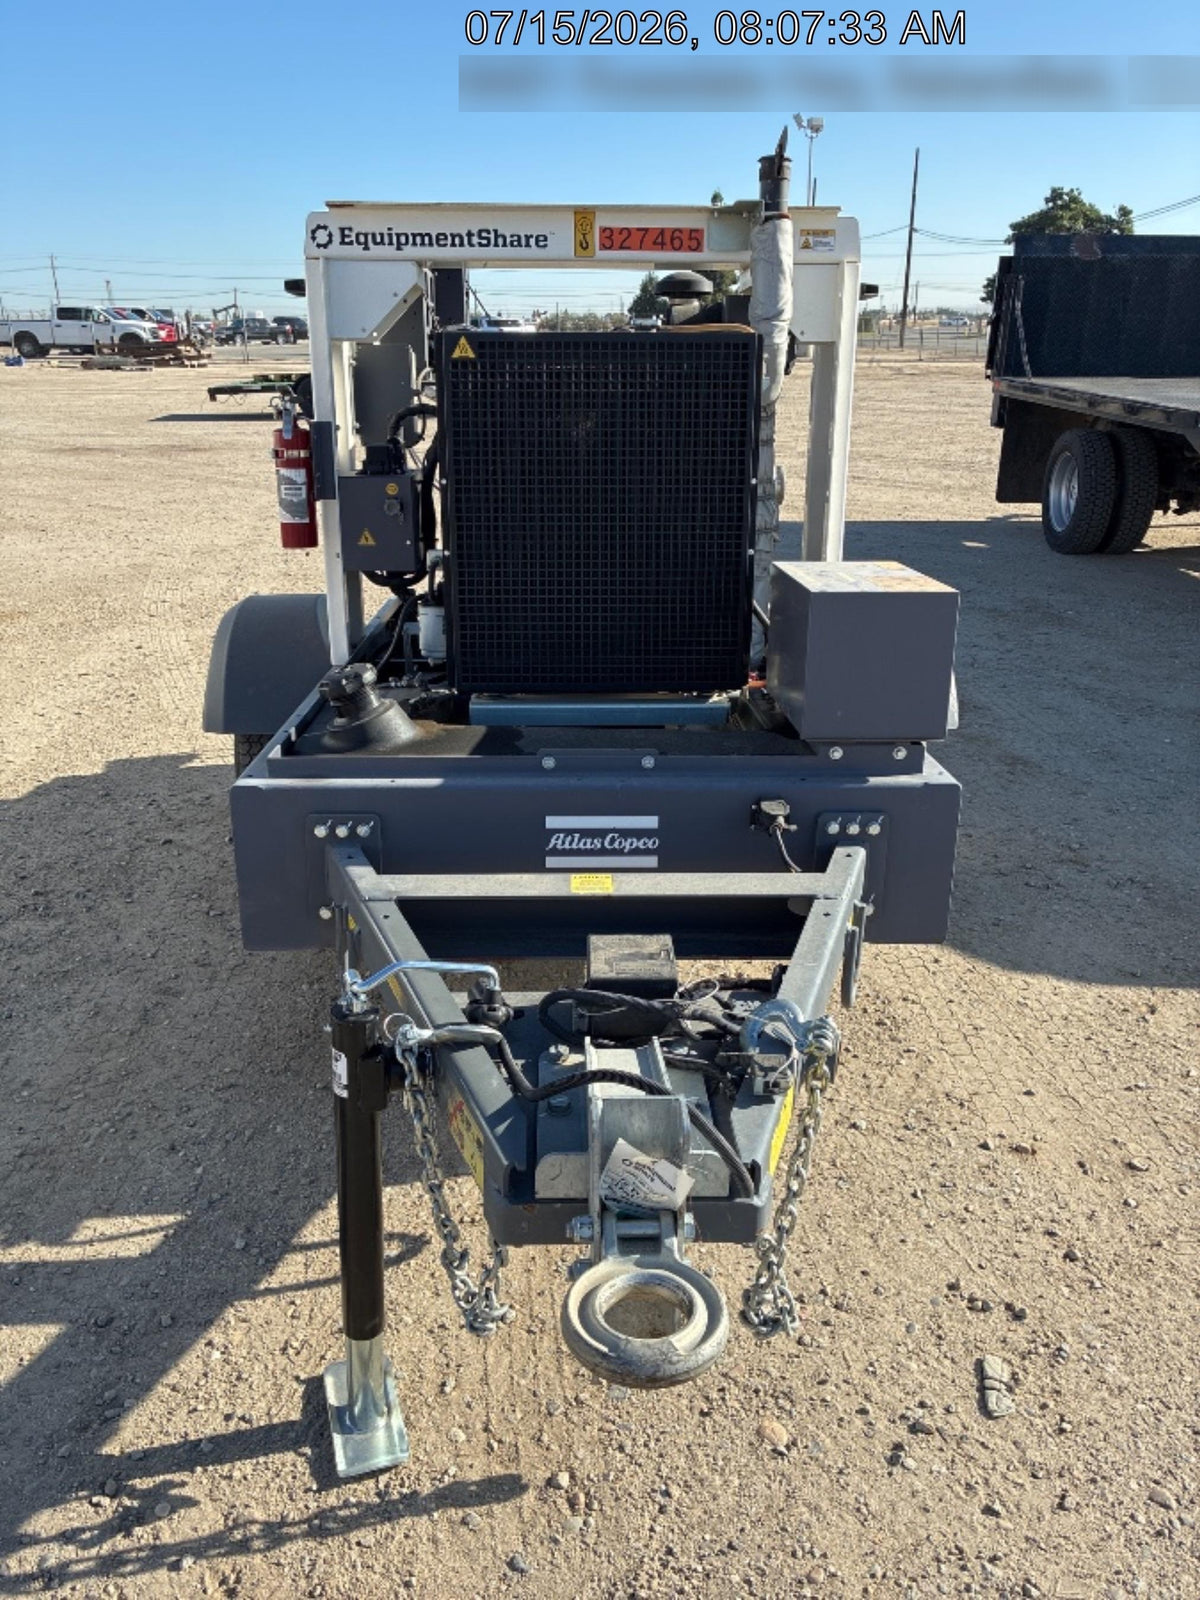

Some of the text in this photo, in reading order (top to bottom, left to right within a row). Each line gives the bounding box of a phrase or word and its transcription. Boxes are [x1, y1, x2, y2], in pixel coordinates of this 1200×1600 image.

[338, 227, 549, 251] EquipmentShare
[601, 227, 701, 251] 327465
[545, 833, 659, 853] Atlas Copco
